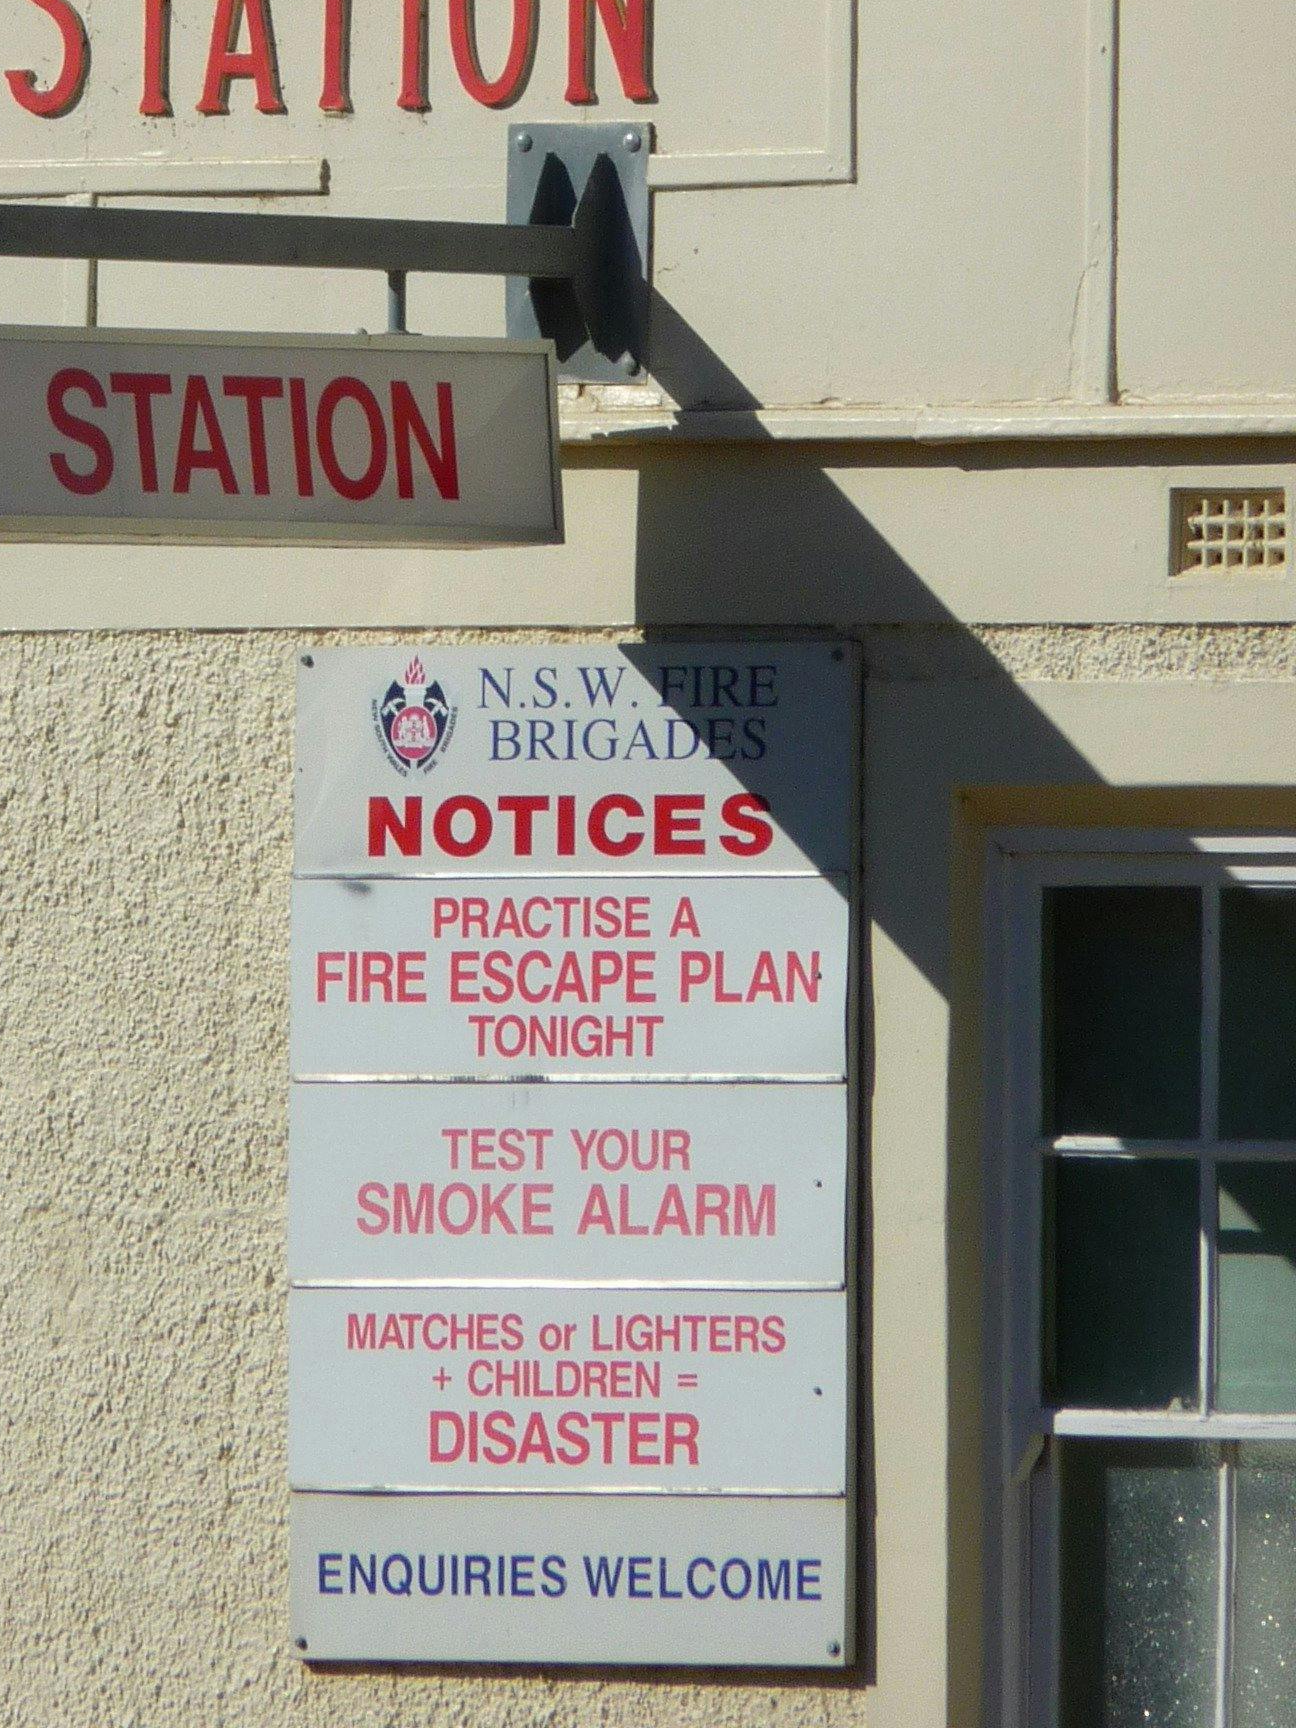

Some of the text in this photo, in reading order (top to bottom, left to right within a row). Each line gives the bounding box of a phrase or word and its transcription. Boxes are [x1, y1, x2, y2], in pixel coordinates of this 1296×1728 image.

[46, 367, 460, 501] STATION
[477, 664, 780, 709] N.S.W. FIRE
[489, 718, 767, 761] BRIGADES
[368, 792, 774, 858] NOTICES
[432, 896, 701, 939] PRACTISE A
[316, 950, 821, 1003] FIRE ESCAPE PLAN
[468, 1014, 664, 1058] TONIGHT
[441, 1128, 692, 1172] TEST YOUR
[356, 1182, 777, 1237] SMOKE ALARM
[347, 1313, 787, 1354] MATCHES or LIGHTERS
[432, 1360, 698, 1398] + CHILDREN =
[429, 1410, 700, 1465] DISASTER
[318, 1553, 823, 1601] ENQUIRIES WELCOME
